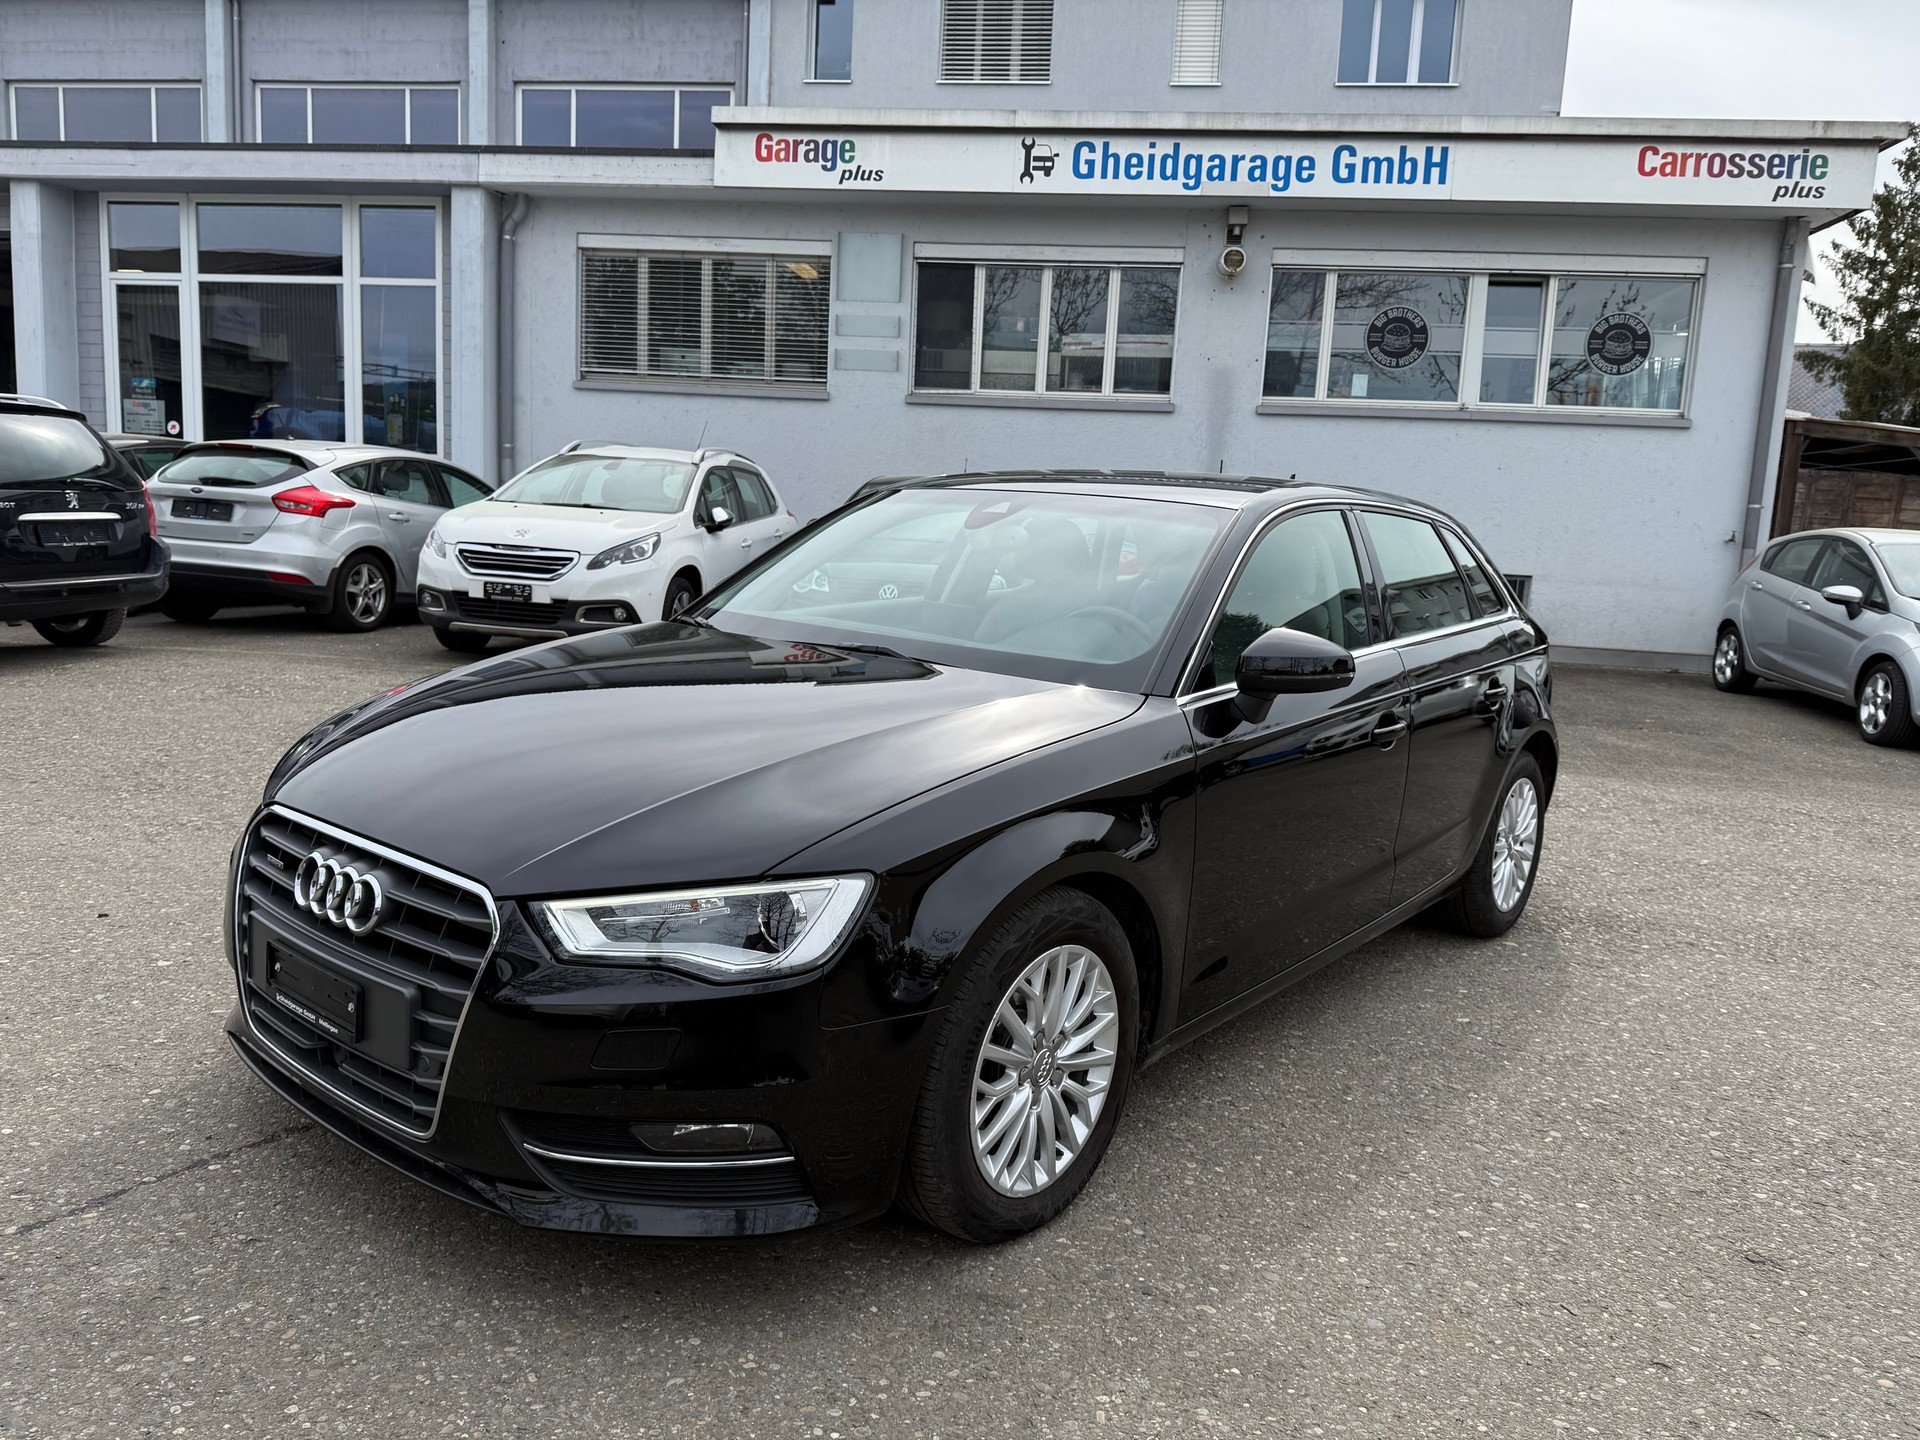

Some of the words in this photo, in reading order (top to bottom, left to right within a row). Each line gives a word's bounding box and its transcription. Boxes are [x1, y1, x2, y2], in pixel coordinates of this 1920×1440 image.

[755, 132, 856, 172] Garage
[1637, 145, 1830, 180] Carrosserie
[838, 164, 885, 185] plus
[1071, 140, 1317, 192] Gheidgarage
[1331, 144, 1450, 186] GmbH
[1771, 180, 1827, 202] plus
[1373, 313, 1388, 328] BIG
[1387, 308, 1425, 329] BROTHERS
[1594, 320, 1609, 334] BIG
[1608, 314, 1647, 335] BROTHERS
[1370, 346, 1397, 367] BURGER
[1398, 347, 1423, 367] HOUSE
[1590, 353, 1618, 374] BURGER
[1619, 354, 1645, 374] HOUSE
